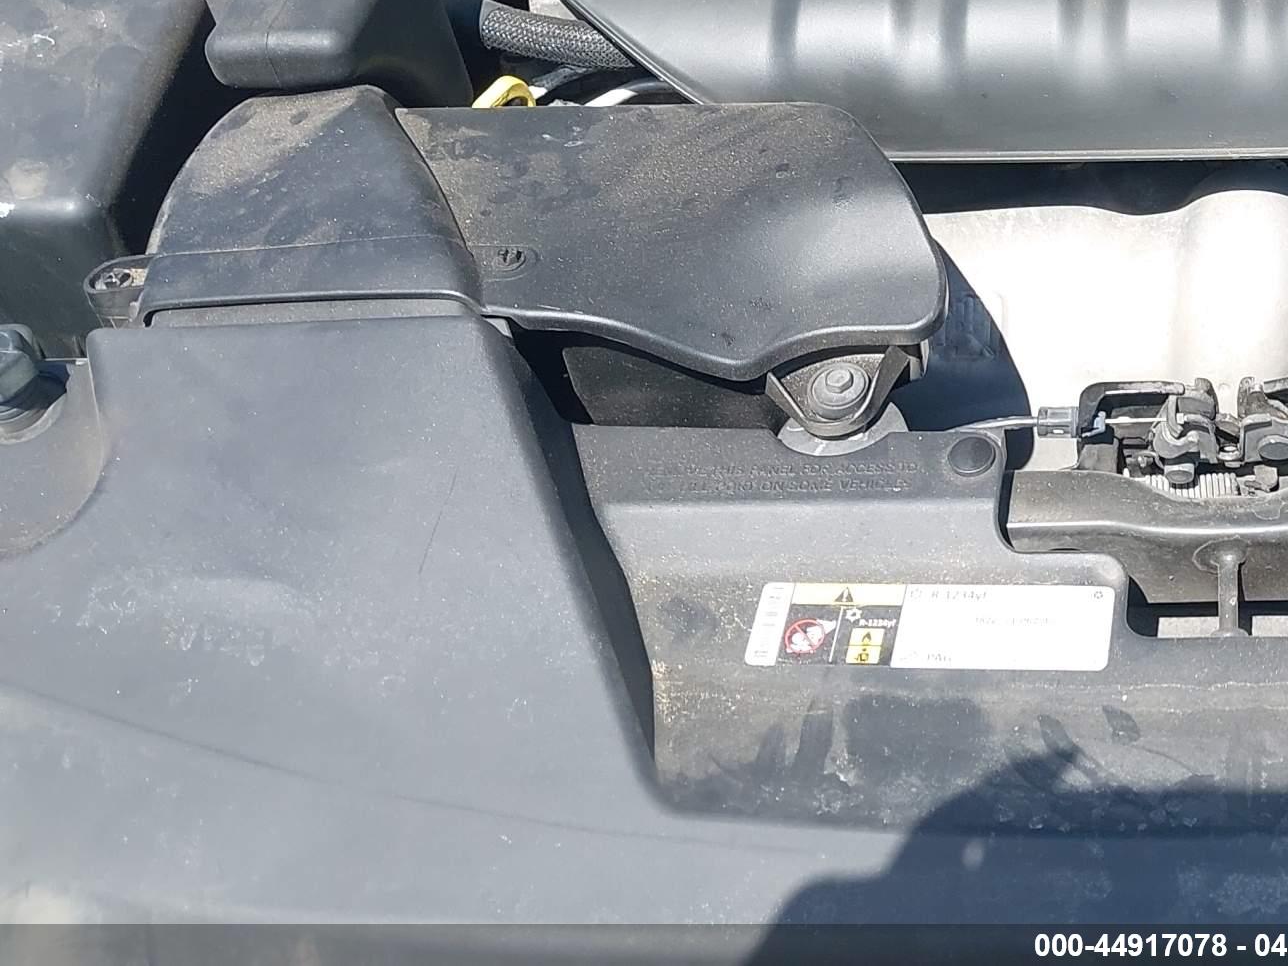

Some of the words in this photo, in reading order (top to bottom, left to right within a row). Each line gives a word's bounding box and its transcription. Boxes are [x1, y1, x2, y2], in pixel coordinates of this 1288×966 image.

[750, 465, 796, 477] PANEL
[800, 464, 830, 476] FOR
[759, 479, 784, 492] ON
[931, 590, 988, 601] R1234yf
